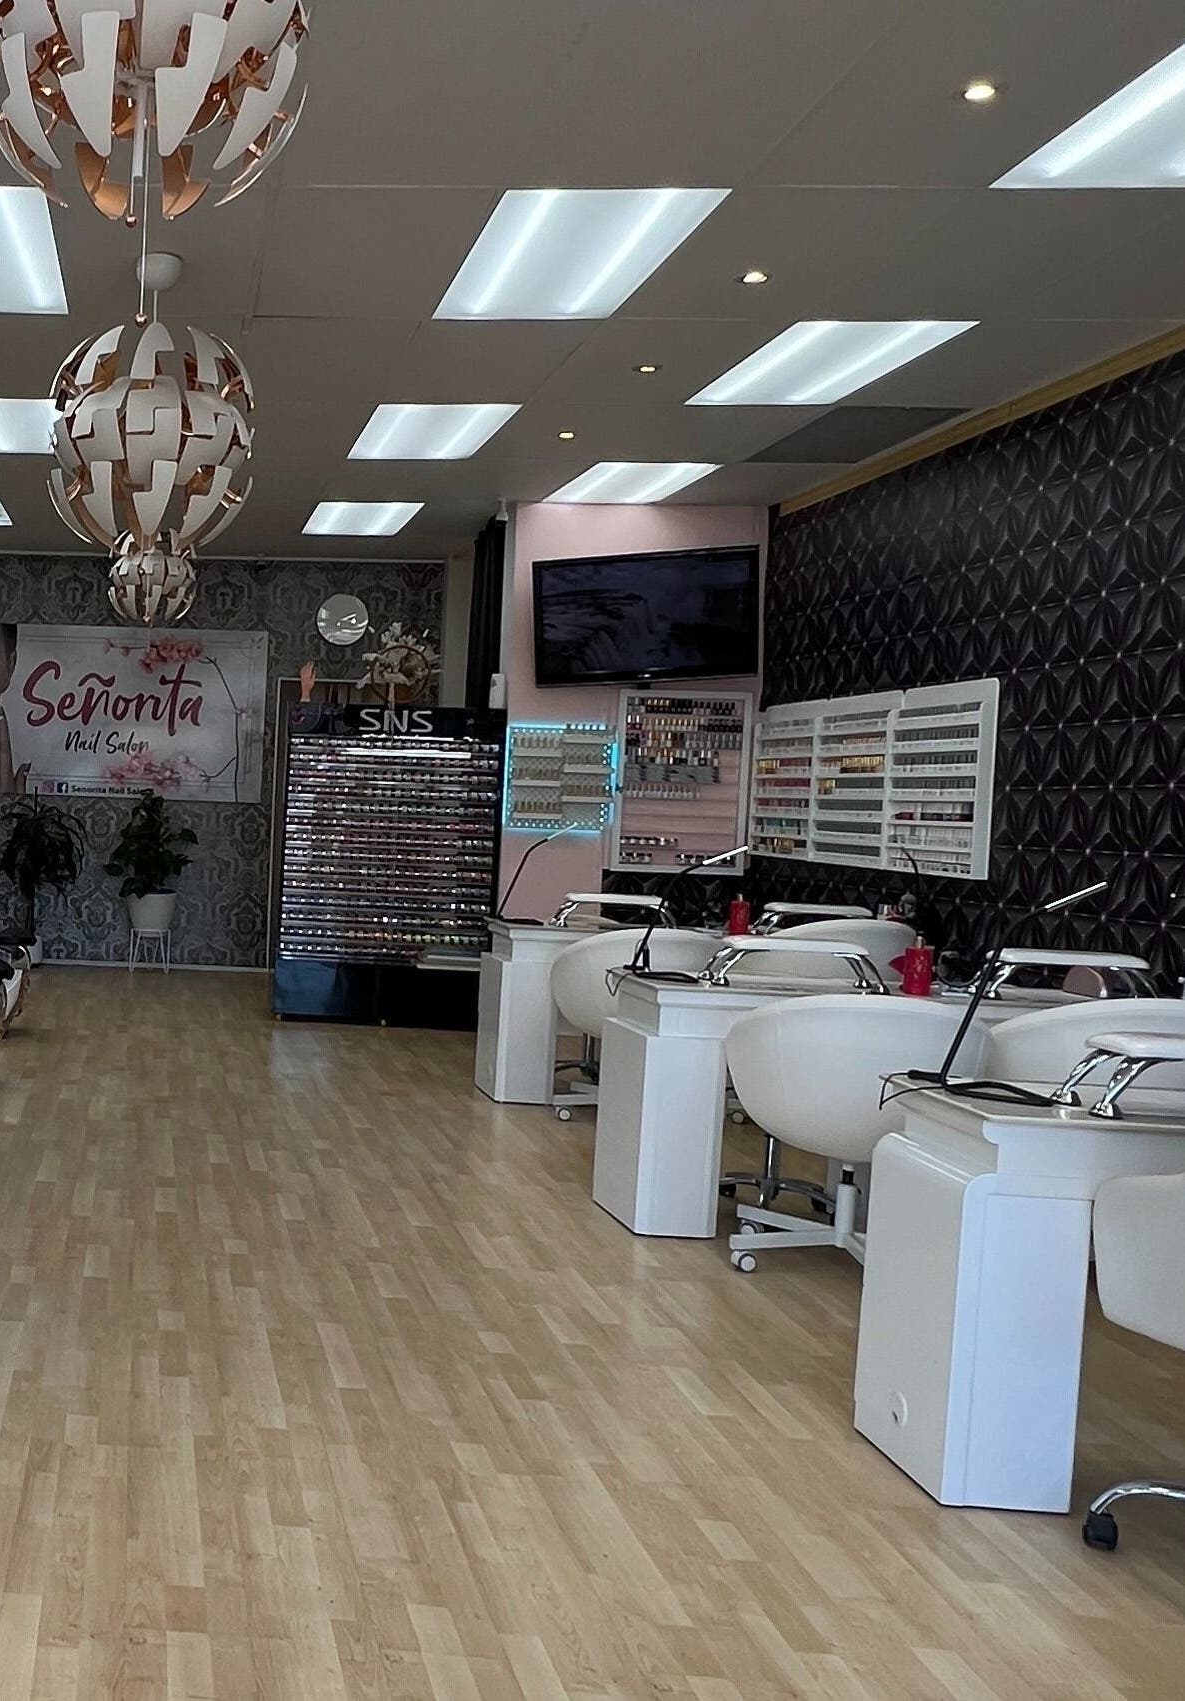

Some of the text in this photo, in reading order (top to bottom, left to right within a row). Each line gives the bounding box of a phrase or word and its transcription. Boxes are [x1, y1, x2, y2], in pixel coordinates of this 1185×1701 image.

[358, 708, 433, 734] SNS
[64, 730, 149, 755] Nail Salon
[108, 786, 125, 795] Nail
